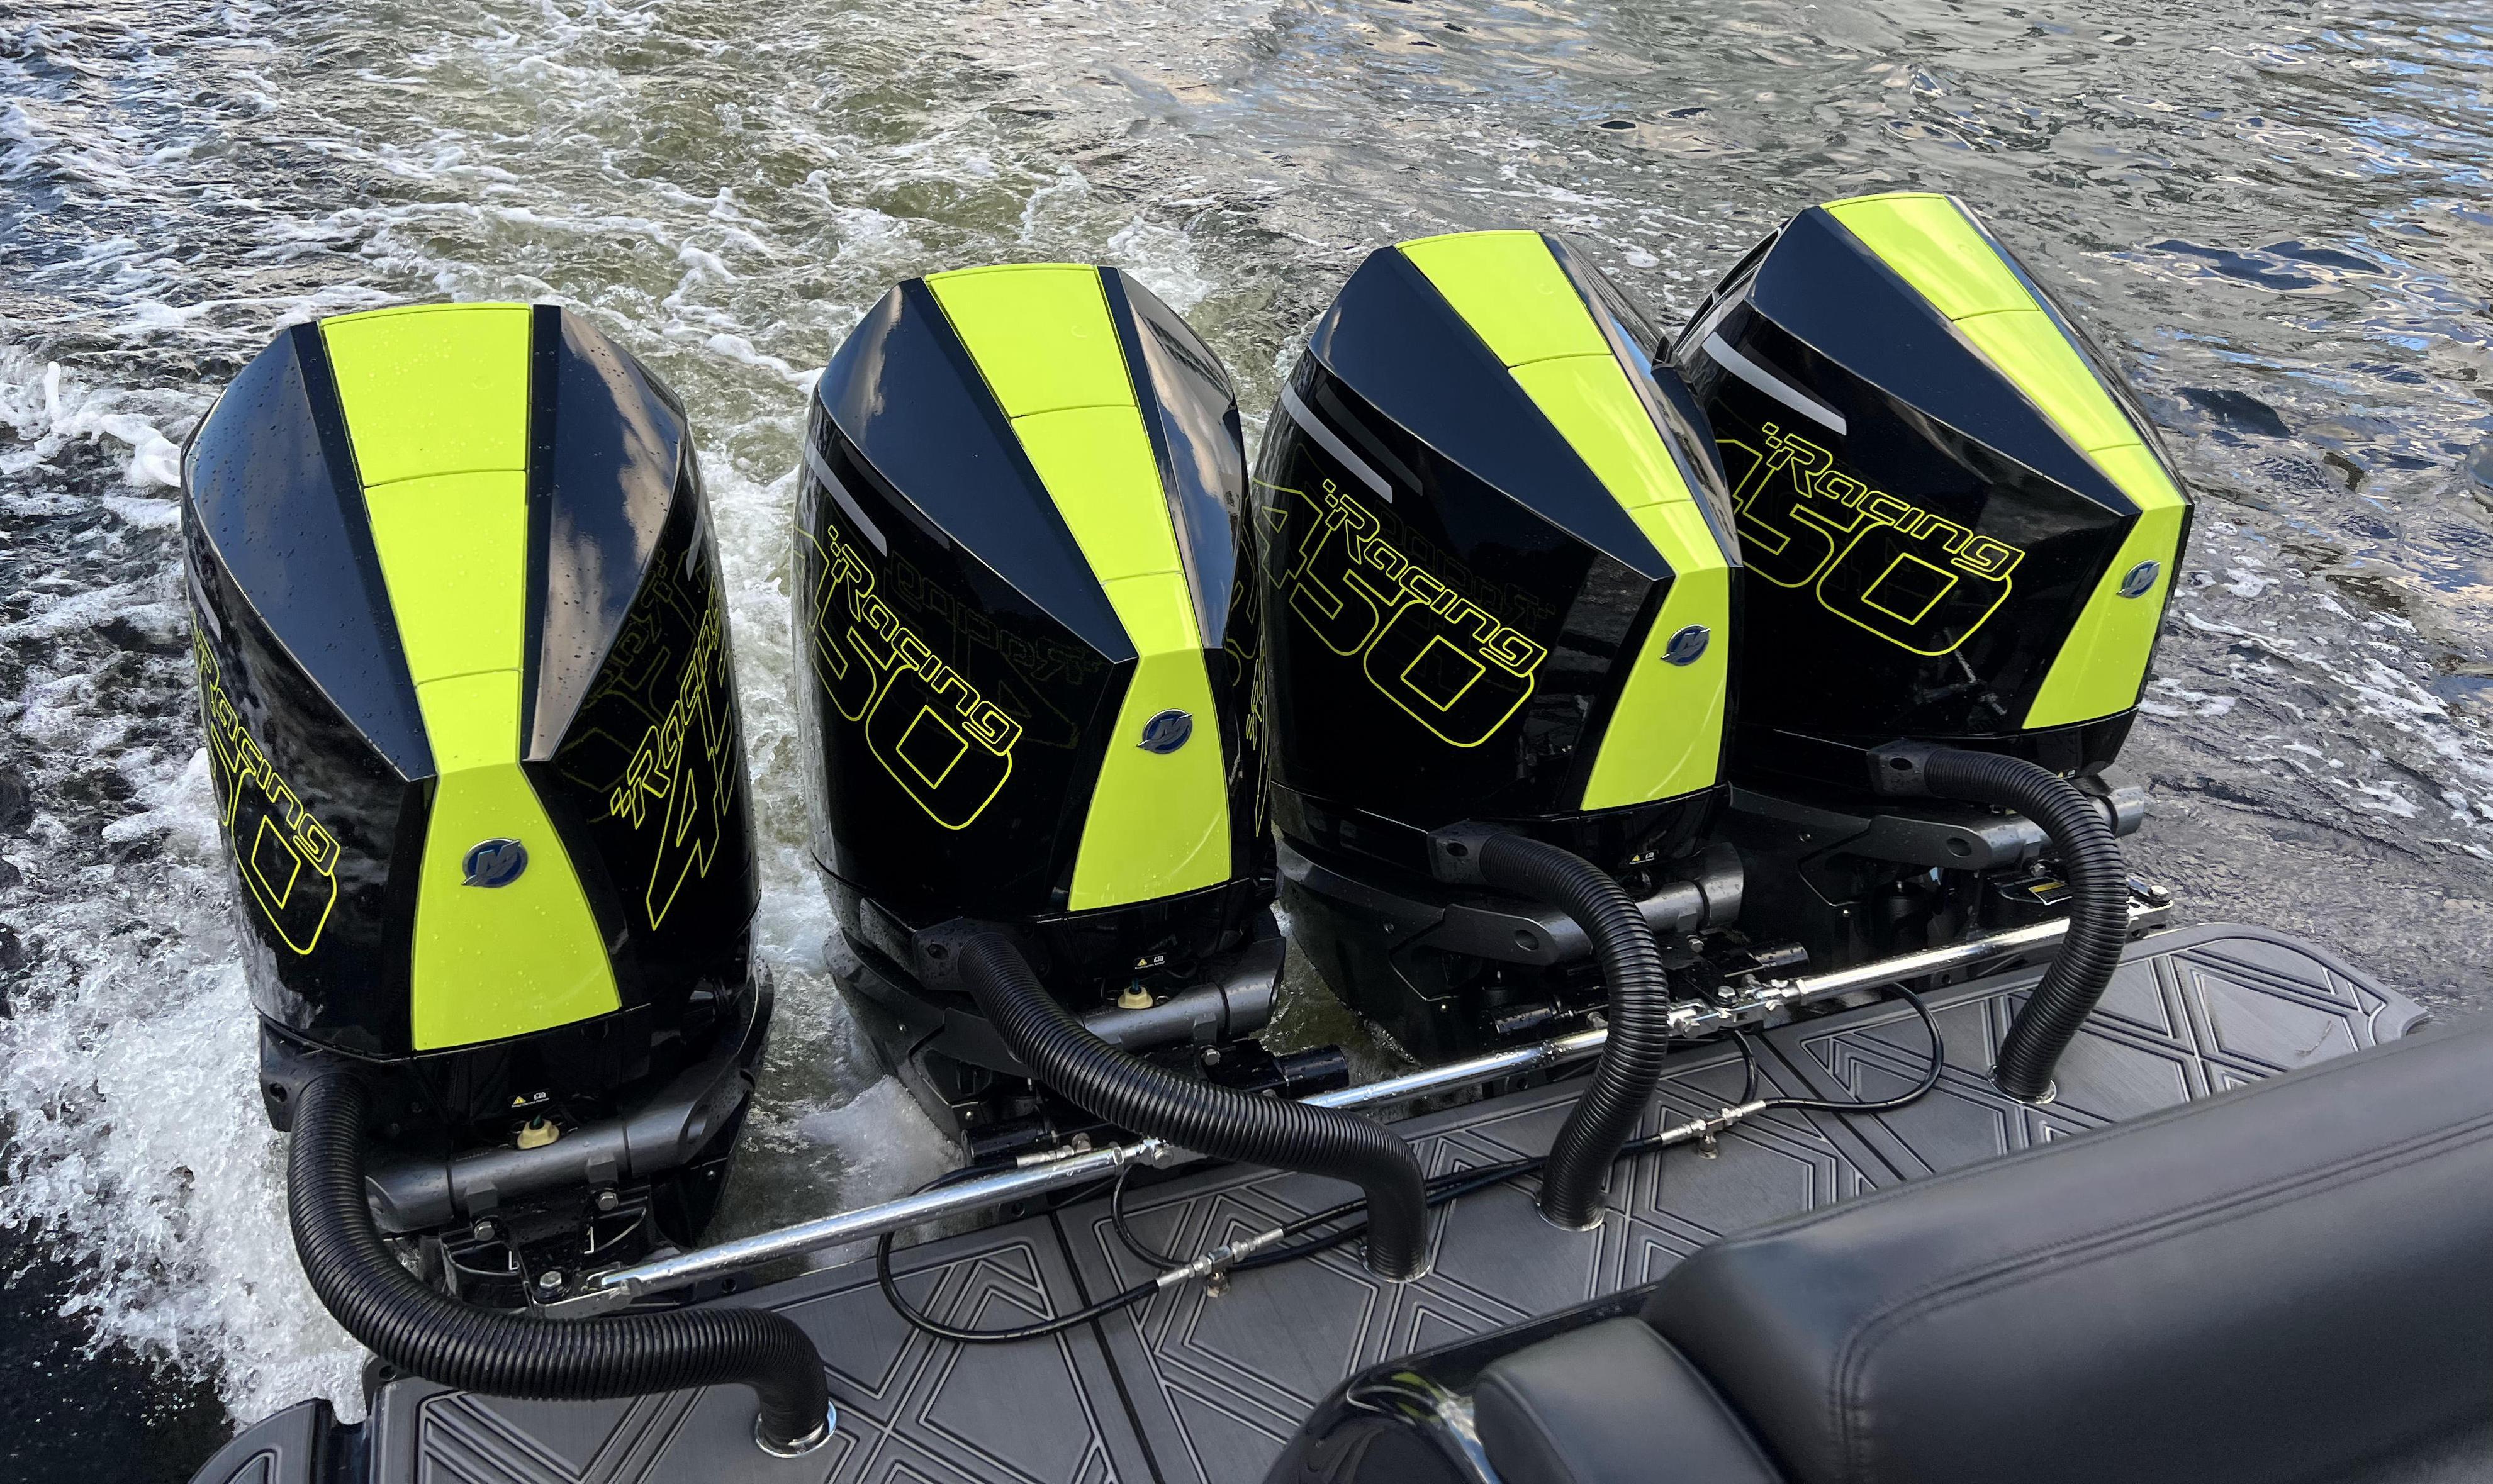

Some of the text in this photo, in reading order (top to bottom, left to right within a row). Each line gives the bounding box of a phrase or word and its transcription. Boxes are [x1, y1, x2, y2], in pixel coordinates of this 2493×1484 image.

[1325, 493, 1549, 678] Racing
[1766, 433, 2025, 582] Racing
[831, 544, 1023, 756] Racing
[191, 628, 341, 877] Racing
